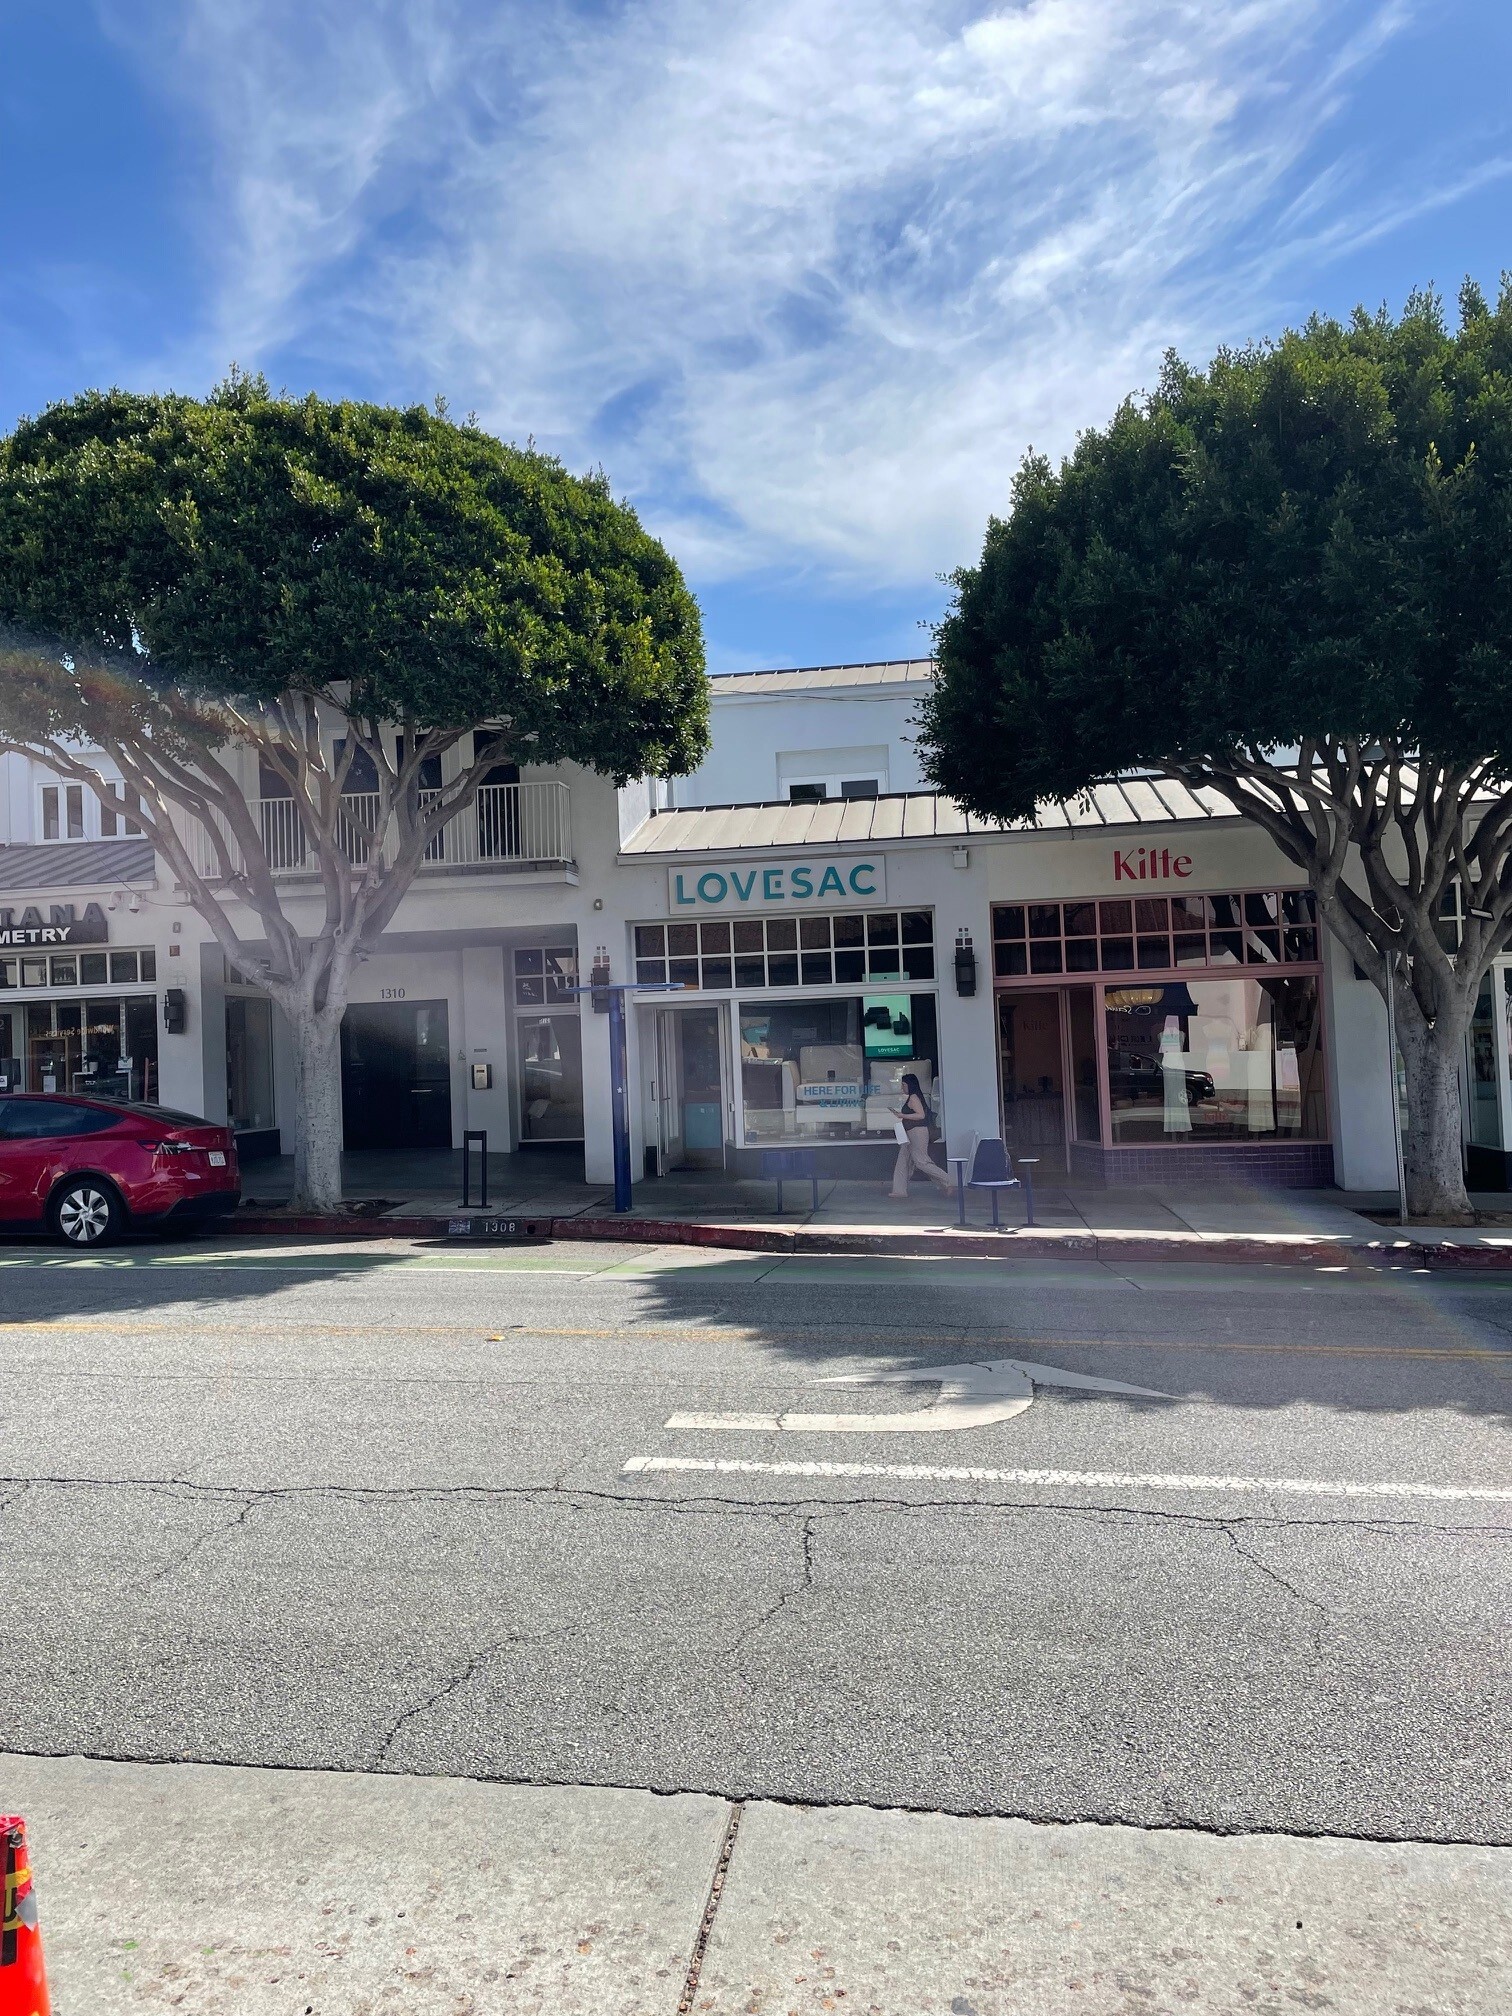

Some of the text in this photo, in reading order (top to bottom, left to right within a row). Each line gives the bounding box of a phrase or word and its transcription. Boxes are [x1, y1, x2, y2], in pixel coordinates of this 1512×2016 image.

[1114, 847, 1193, 880] Kilte
[676, 864, 878, 905] LOVESAC
[380, 988, 406, 998] 1310
[804, 1084, 881, 1095] HERE FOR LIFE
[485, 1222, 516, 1232] 1308
